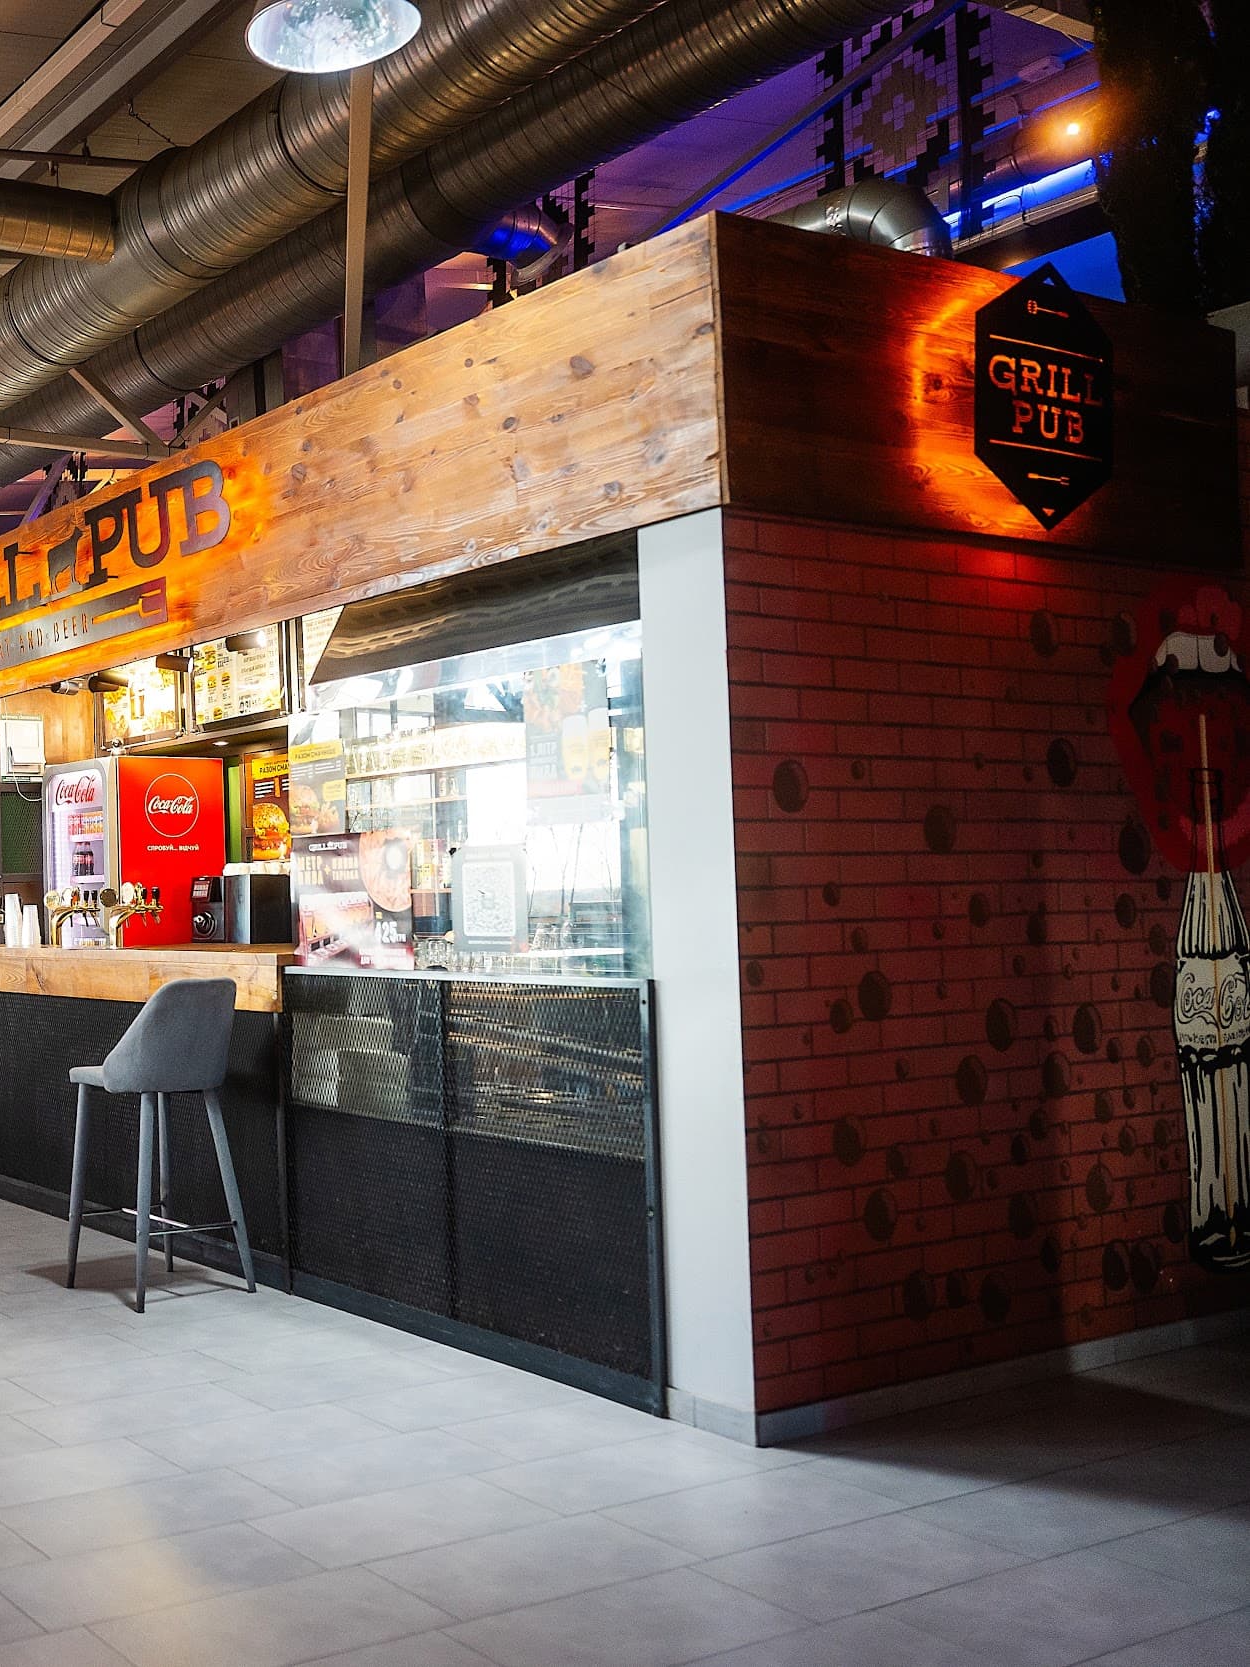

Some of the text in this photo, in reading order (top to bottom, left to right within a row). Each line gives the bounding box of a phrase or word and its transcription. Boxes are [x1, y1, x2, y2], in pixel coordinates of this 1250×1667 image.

[988, 354, 1101, 407] GRILL
[1011, 400, 1084, 443] PUB
[83, 459, 232, 585] PUB
[52, 612, 88, 644] BEER
[55, 774, 97, 806] Coca-Cola
[147, 795, 196, 816] Coca-Cola
[1176, 972, 1219, 1028] Coca
